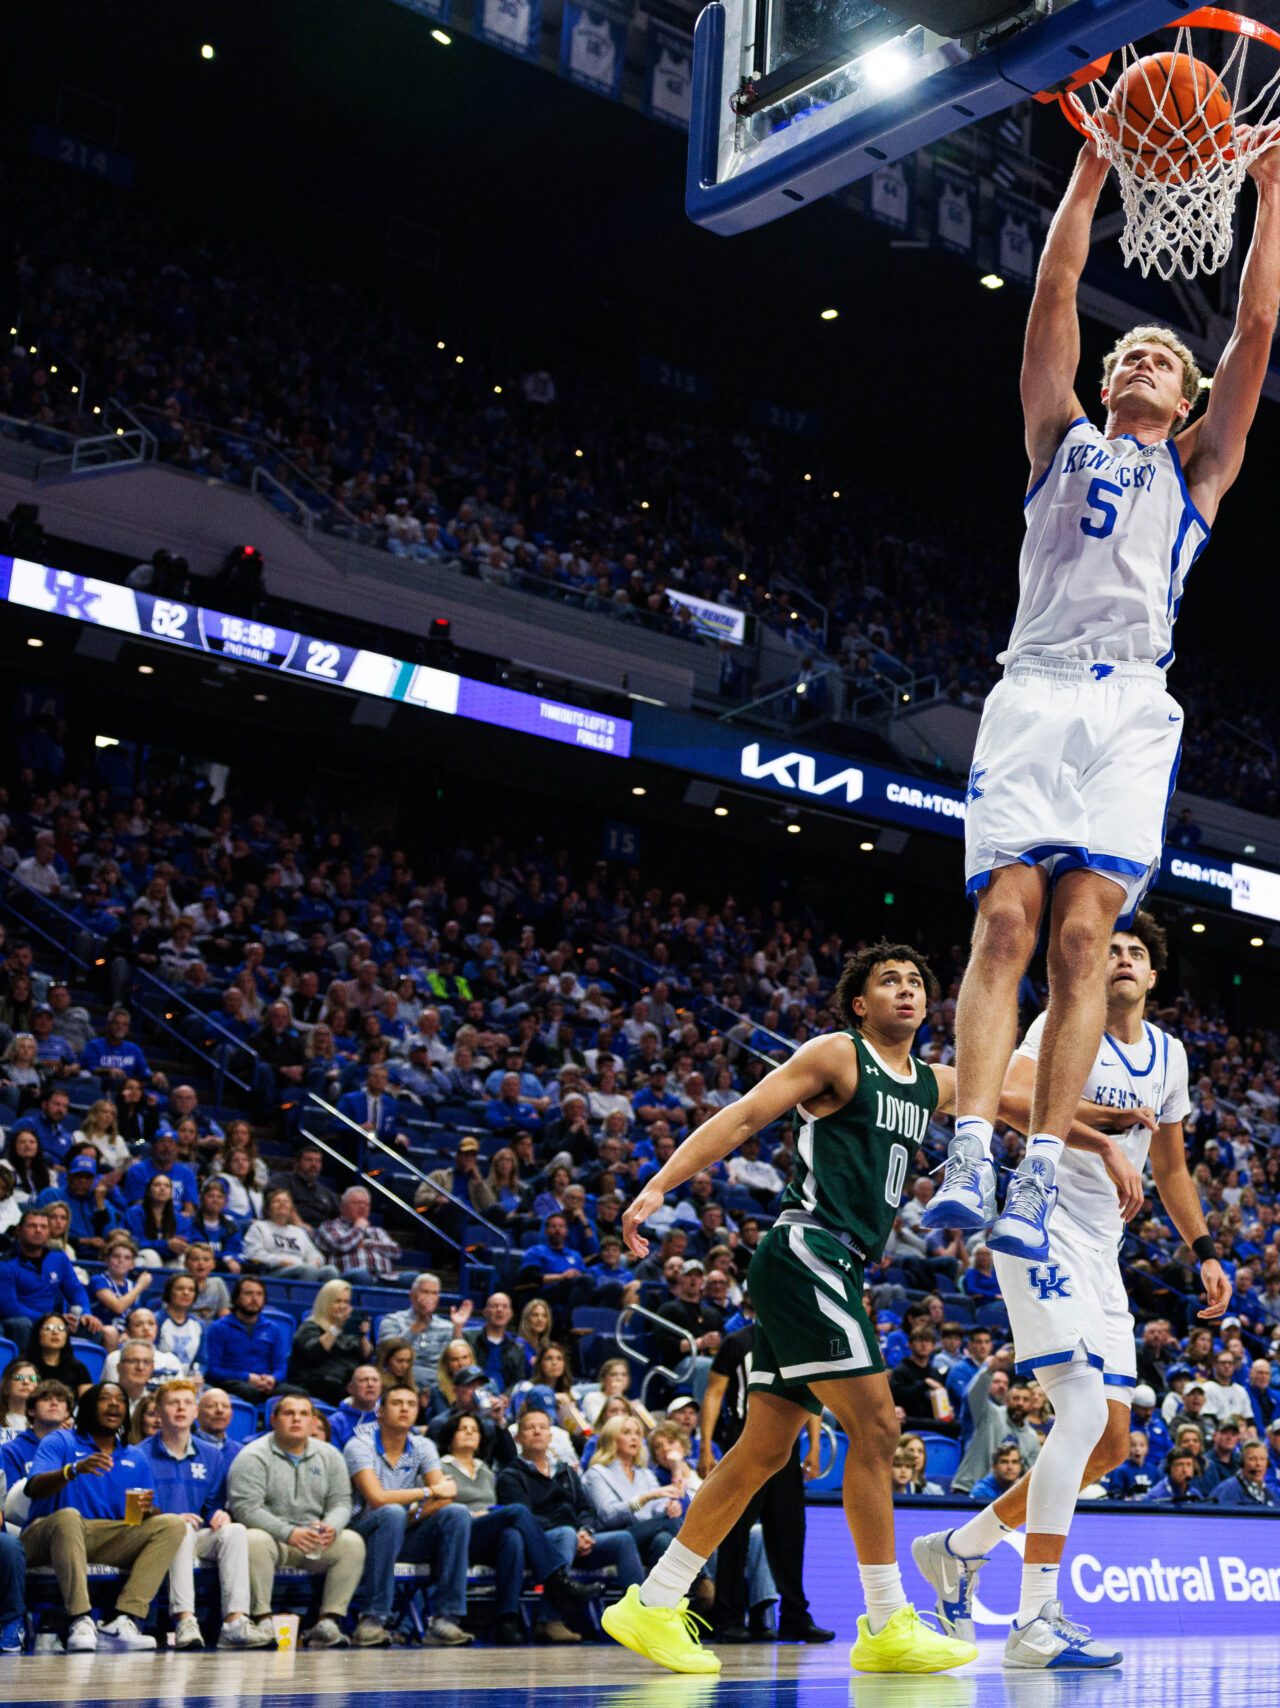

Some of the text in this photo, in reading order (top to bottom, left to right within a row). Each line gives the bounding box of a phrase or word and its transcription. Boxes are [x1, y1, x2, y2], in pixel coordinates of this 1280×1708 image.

[1080, 477, 1123, 539] 5
[151, 600, 188, 640] 52
[306, 641, 340, 678] 22
[741, 742, 865, 803] KIA
[887, 783, 924, 808] CAR
[608, 829, 635, 854] 15
[885, 1143, 908, 1208] 0
[1027, 1263, 1072, 1300] UK
[1070, 1553, 1216, 1603] Central
